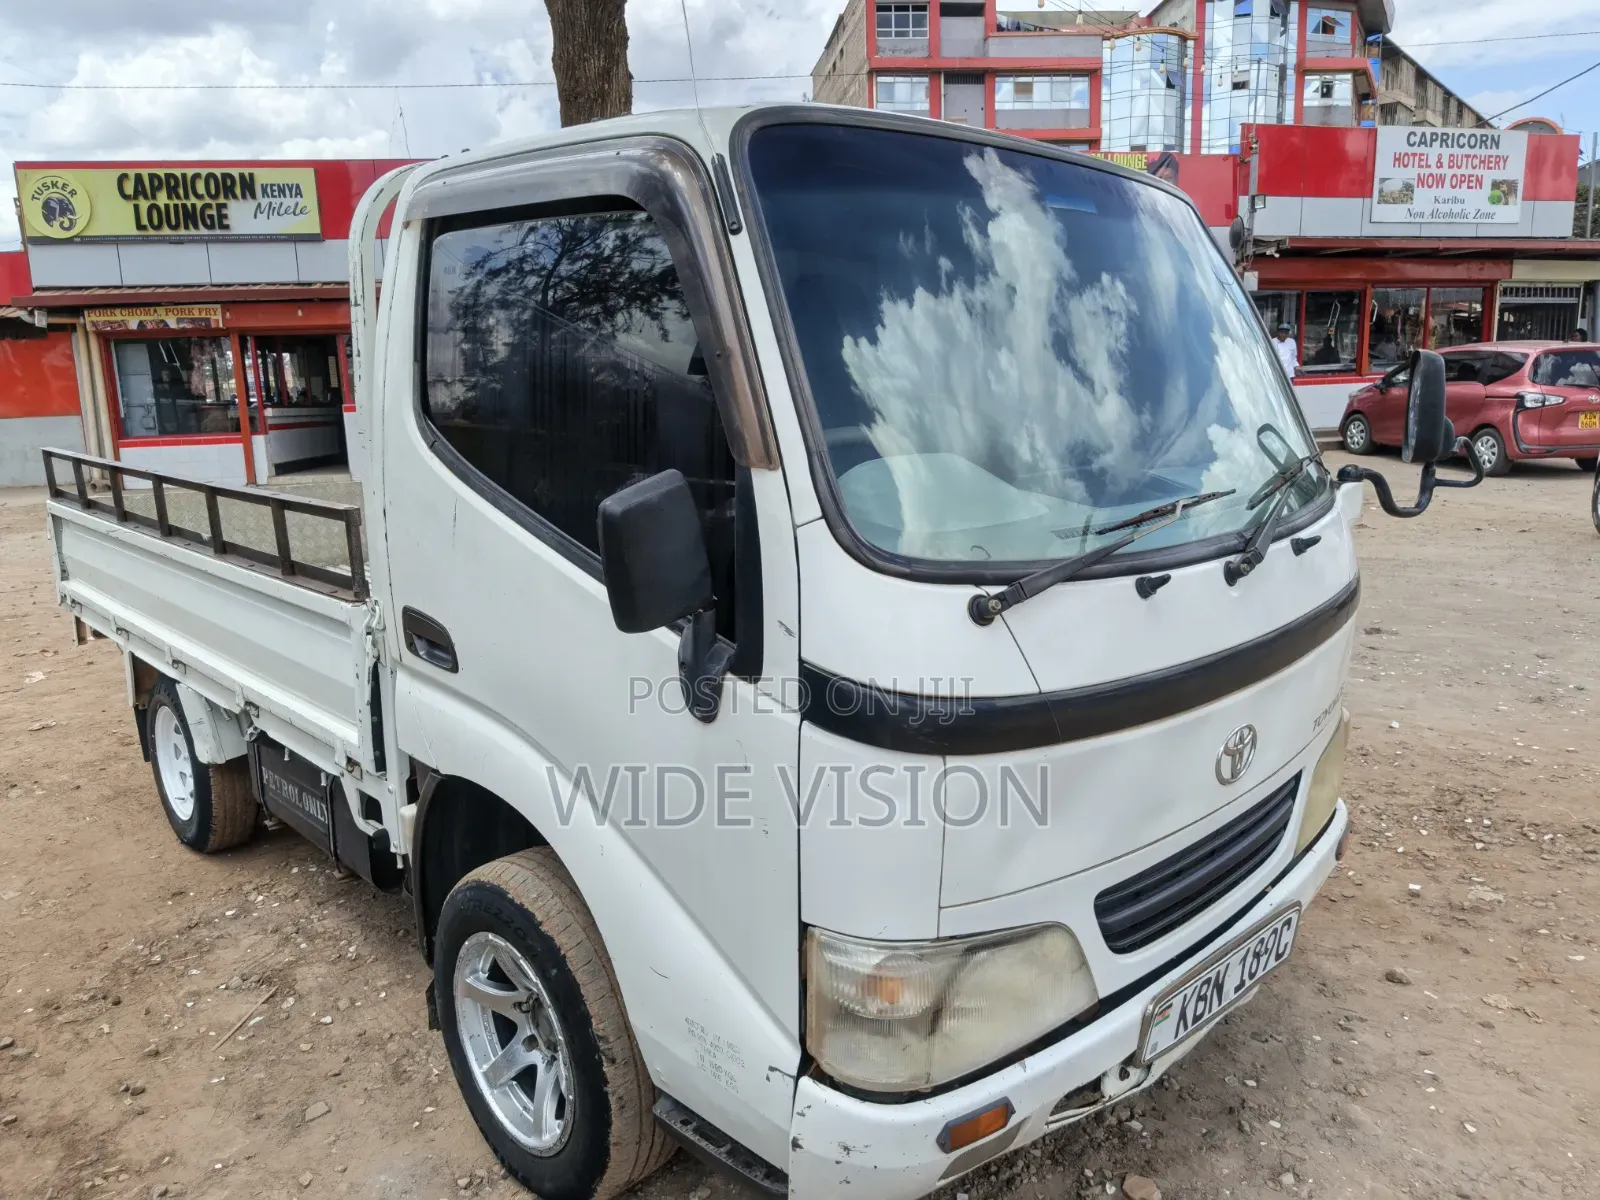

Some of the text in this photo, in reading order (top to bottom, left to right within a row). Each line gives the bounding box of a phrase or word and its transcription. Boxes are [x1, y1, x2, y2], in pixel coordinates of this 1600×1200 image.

[1406, 131, 1501, 150] CAPRICORN
[1393, 152, 1509, 171] HOTEL & BUTCHERY
[116, 172, 257, 201] CAPRICORN
[1416, 172, 1484, 190] NOW OPEN
[31, 180, 78, 202] TUSKER
[260, 183, 303, 199] KENYA
[1433, 195, 1465, 205] Karibu
[133, 203, 230, 231] LOUNGE
[253, 202, 311, 220] Milele
[1404, 208, 1496, 220] Non Alcoholic Zone
[87, 309, 117, 318] PORK
[165, 308, 194, 317] PORK
[197, 307, 218, 316] FRY
[261, 766, 328, 824] PETROL ONLY
[1174, 917, 1293, 1040] KBN 189C
